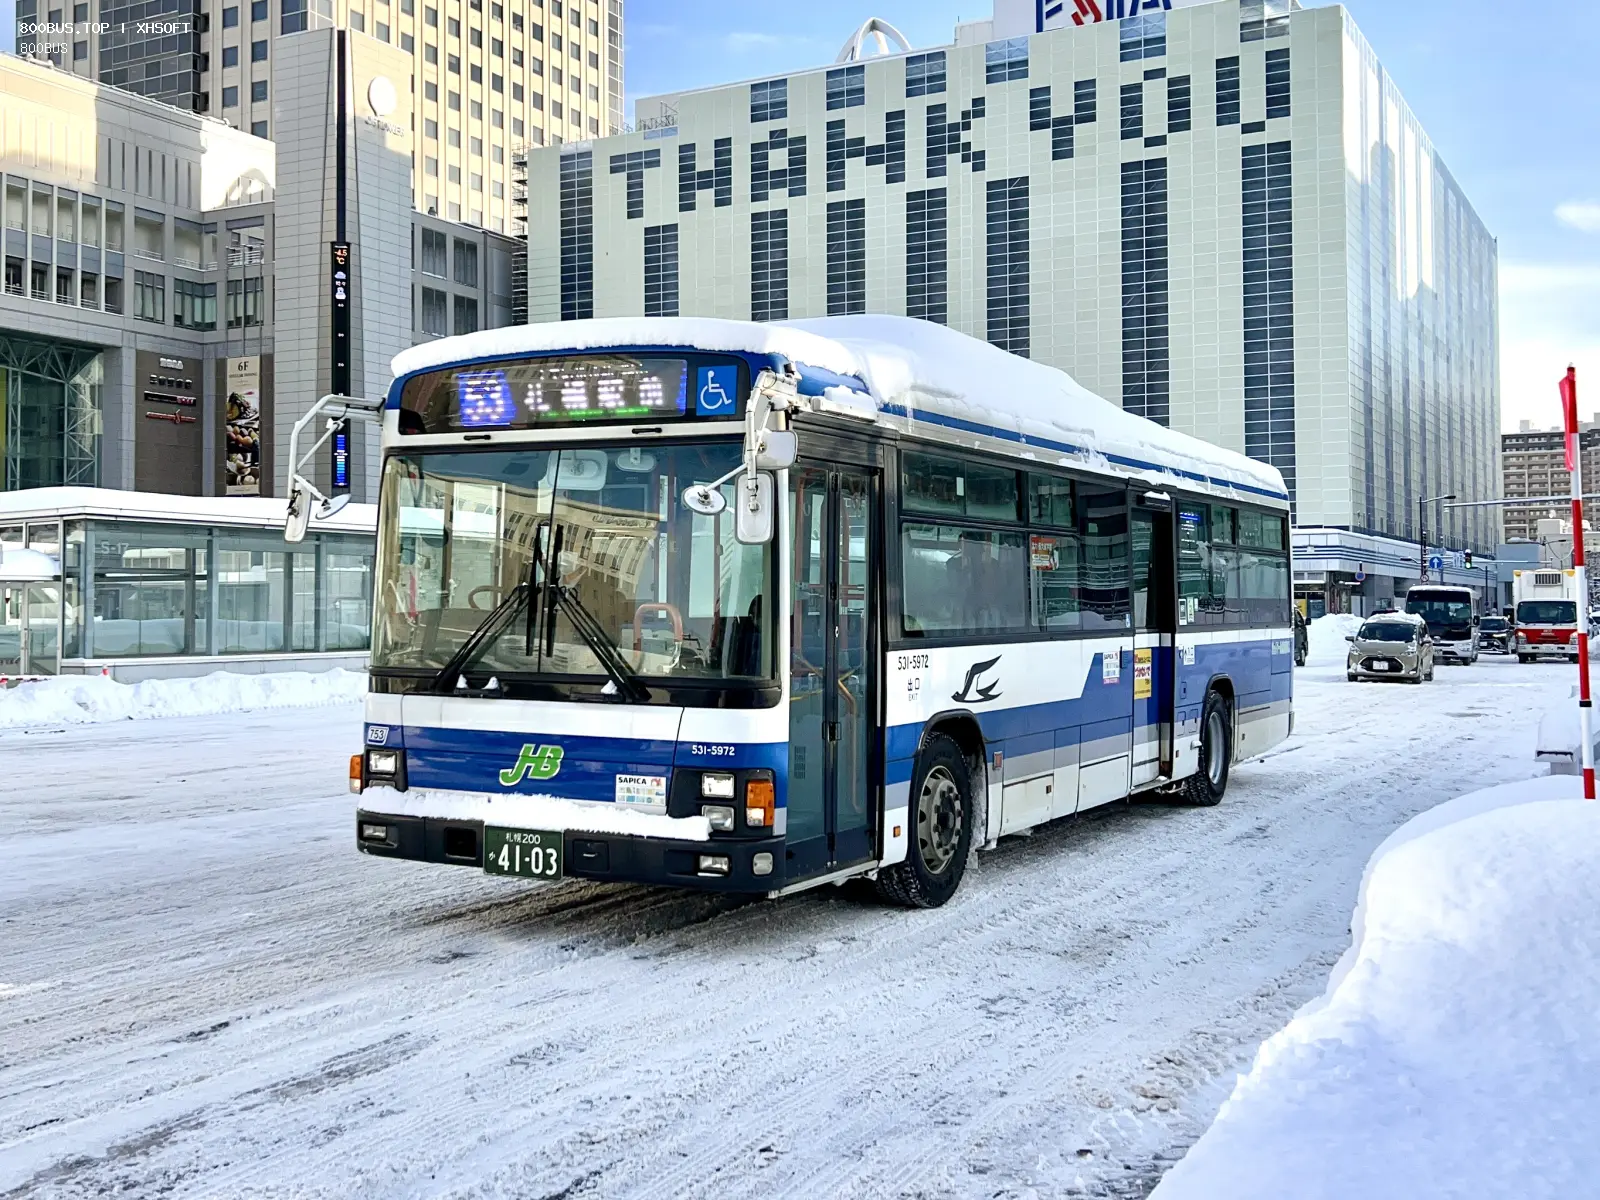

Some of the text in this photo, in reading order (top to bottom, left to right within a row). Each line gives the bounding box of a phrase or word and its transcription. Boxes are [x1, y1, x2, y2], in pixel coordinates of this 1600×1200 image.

[237, 361, 249, 371] 6F
[898, 654, 929, 671] 531-5972
[907, 677, 920, 692] 出口
[370, 729, 385, 740] 753
[691, 744, 736, 756] 531-5972
[618, 776, 647, 785] SAPICA
[498, 843, 558, 876] 41-03
